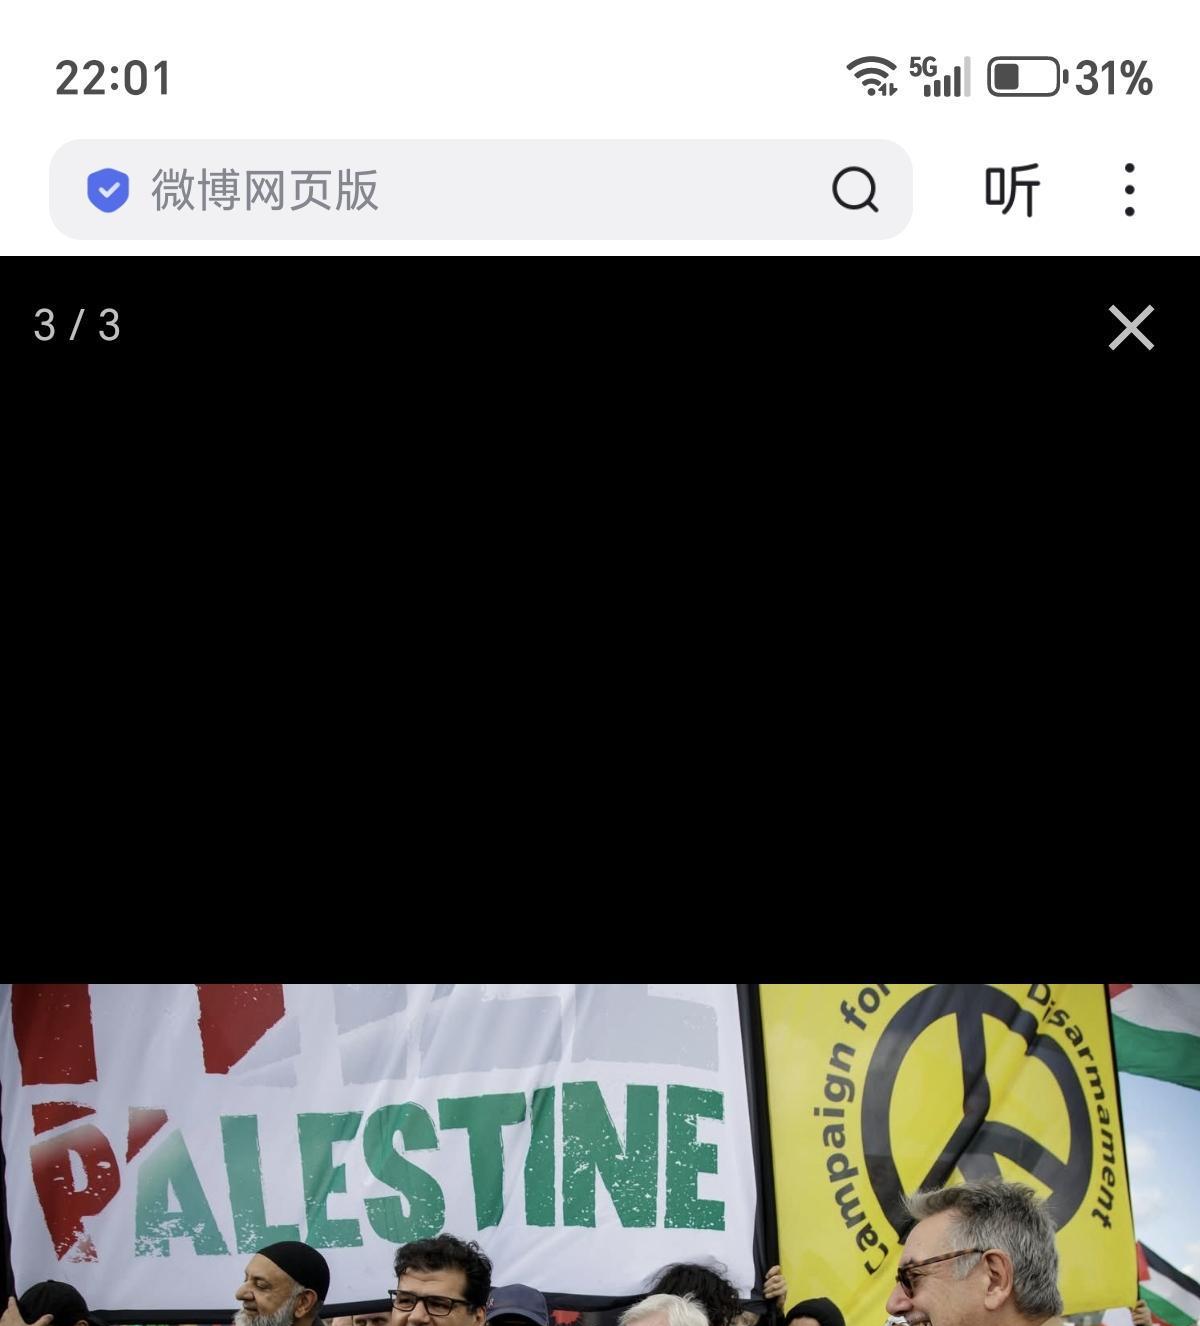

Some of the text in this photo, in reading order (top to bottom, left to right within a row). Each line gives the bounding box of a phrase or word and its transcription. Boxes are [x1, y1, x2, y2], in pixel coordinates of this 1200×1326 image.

[54, 59, 169, 97] 22:01
[909, 55, 939, 78] 5G
[1075, 59, 1154, 97] 31%
[151, 166, 380, 213] 微博网页版
[985, 162, 1042, 218] 听
[1026, 984, 1118, 1230] Disarmament
[29, 1080, 725, 1264] PALESTINE
